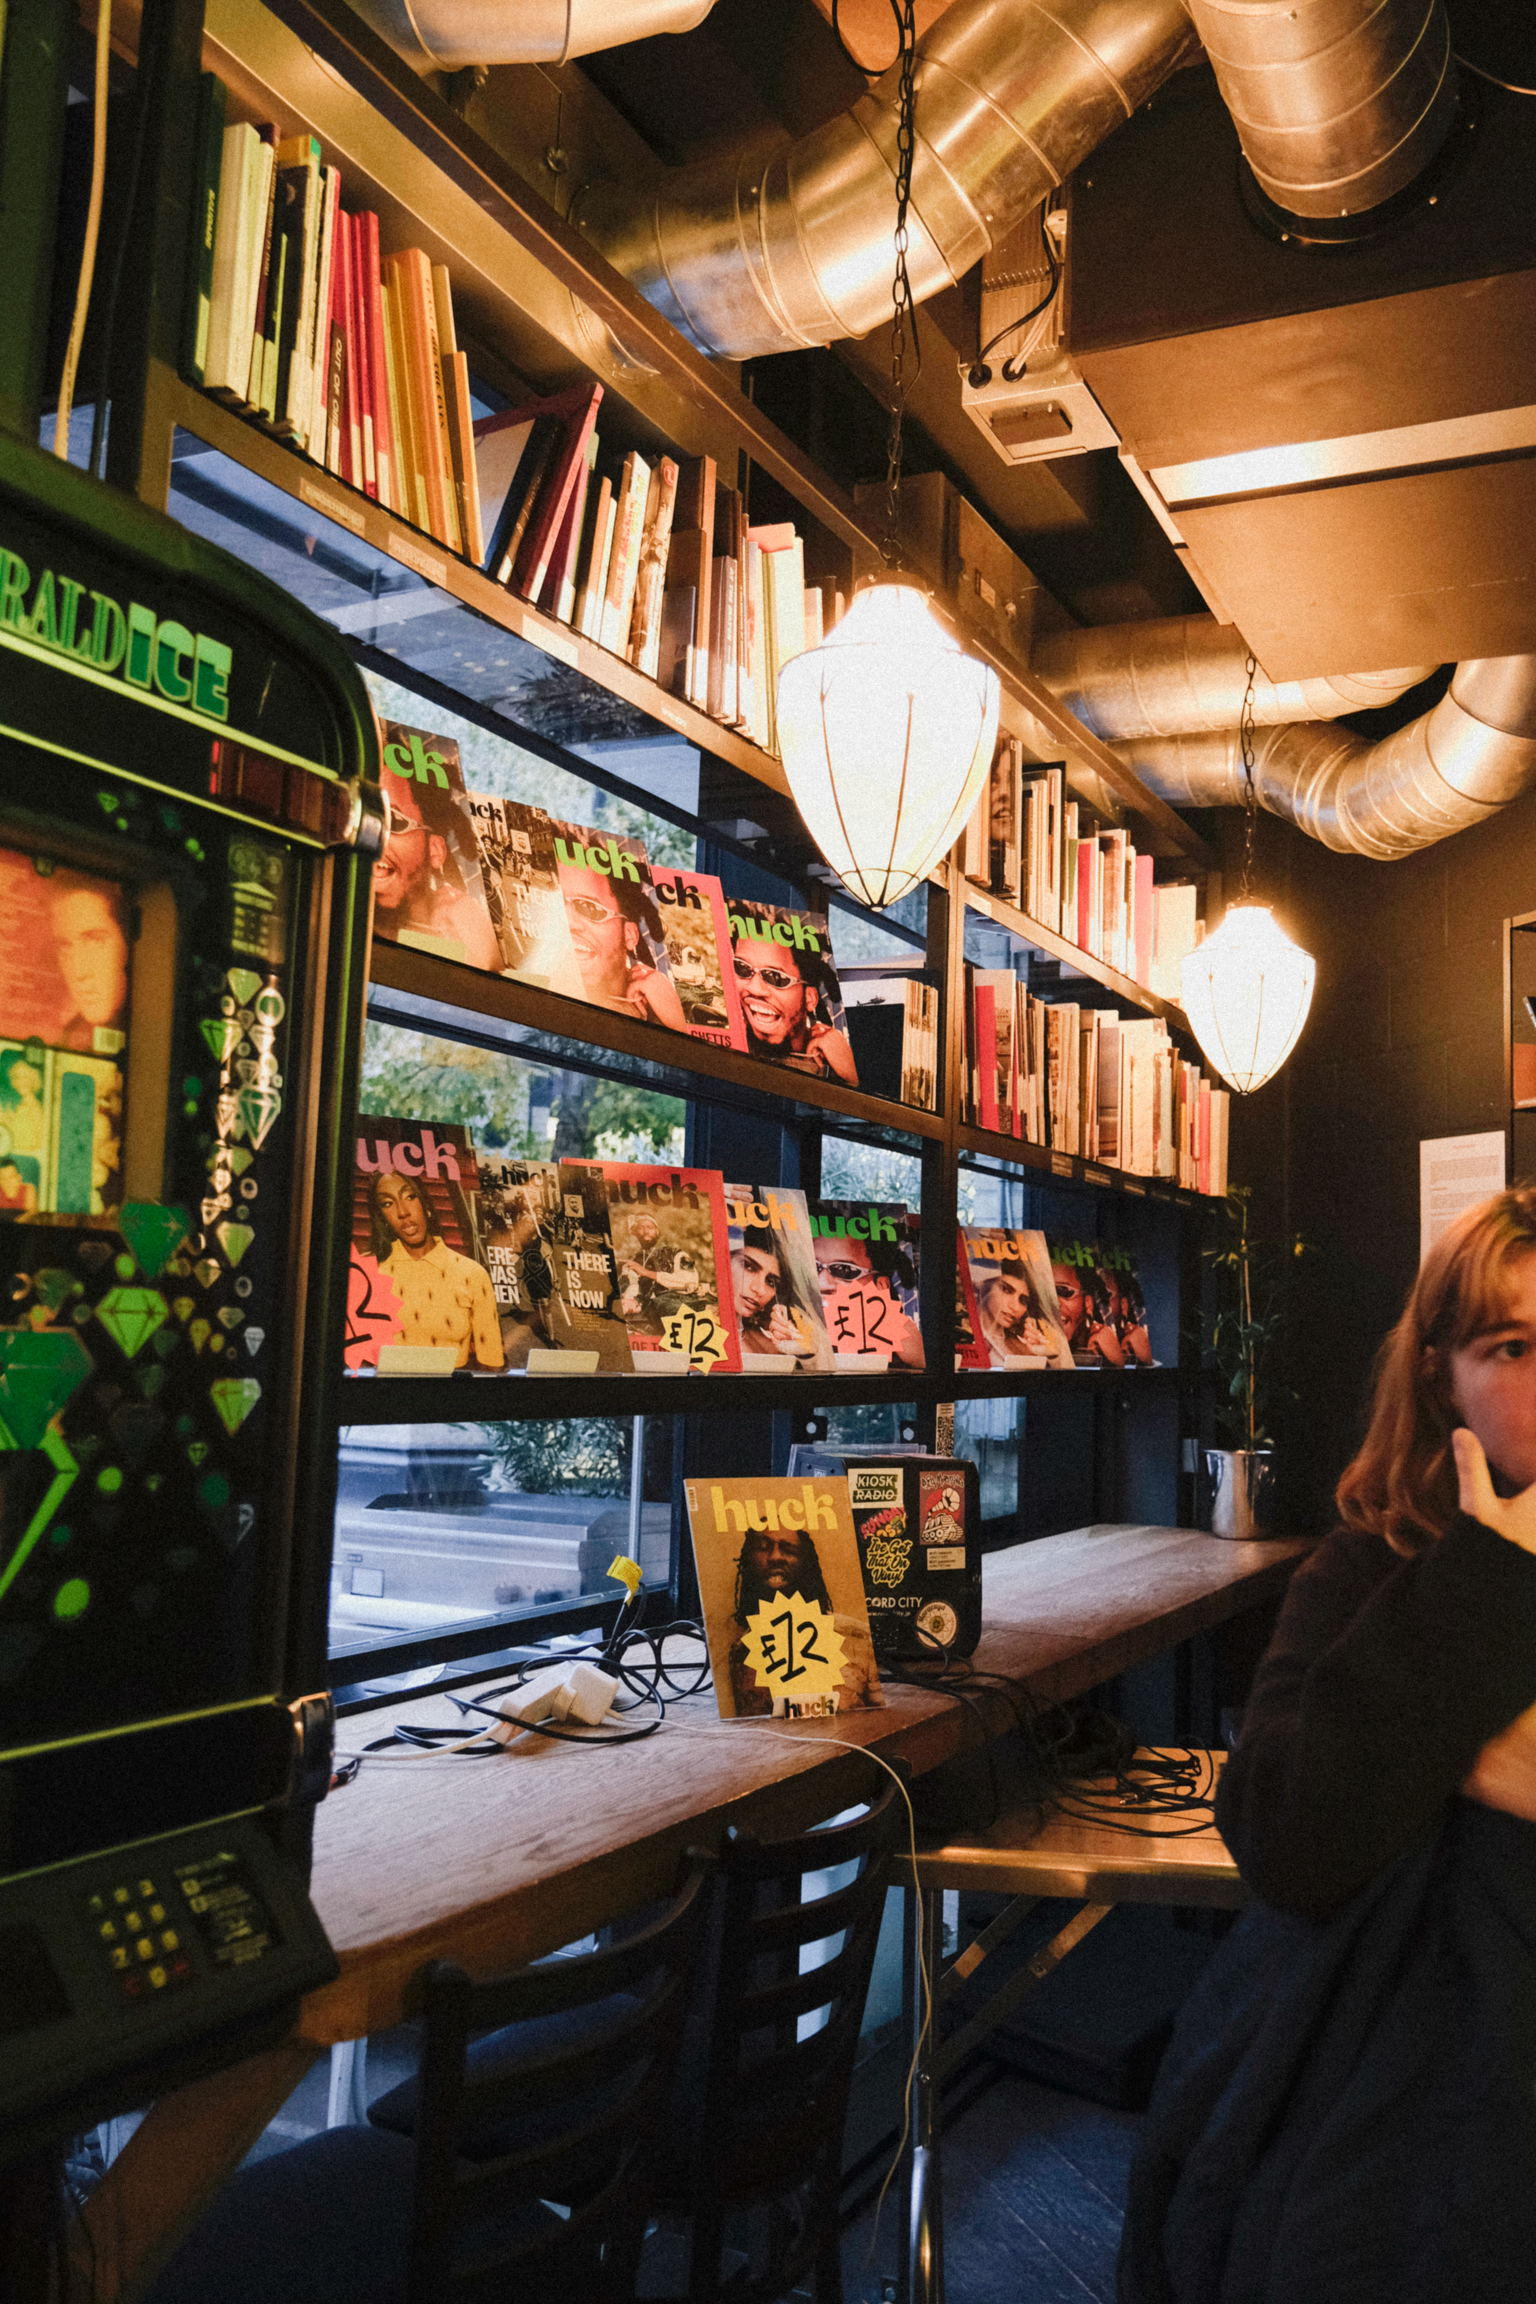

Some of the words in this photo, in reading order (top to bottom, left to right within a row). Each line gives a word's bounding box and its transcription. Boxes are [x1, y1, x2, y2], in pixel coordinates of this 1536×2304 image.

[334, 338, 343, 371] OUT
[332, 373, 341, 396] OF
[384, 735, 449, 789] ck
[356, 1129, 461, 1181] uck
[487, 1245, 516, 1266] ERE
[564, 1251, 612, 1273] THERE
[566, 1270, 582, 1289] IS
[568, 1289, 604, 1309] NOW
[834, 1291, 893, 1354] £12
[669, 1313, 720, 1364] £12
[857, 1475, 895, 1488] KIOSK
[855, 1489, 895, 1501] RADIO
[710, 1484, 838, 1533] huck
[889, 1539, 911, 1555] Got
[868, 1553, 892, 1568] That
[891, 1554, 909, 1569] On
[872, 1567, 903, 1587] Vinyl
[865, 1597, 897, 1609] CORD
[898, 1596, 923, 1609] CITY
[760, 1610, 830, 1683] £12
[784, 1696, 835, 1719] huck
